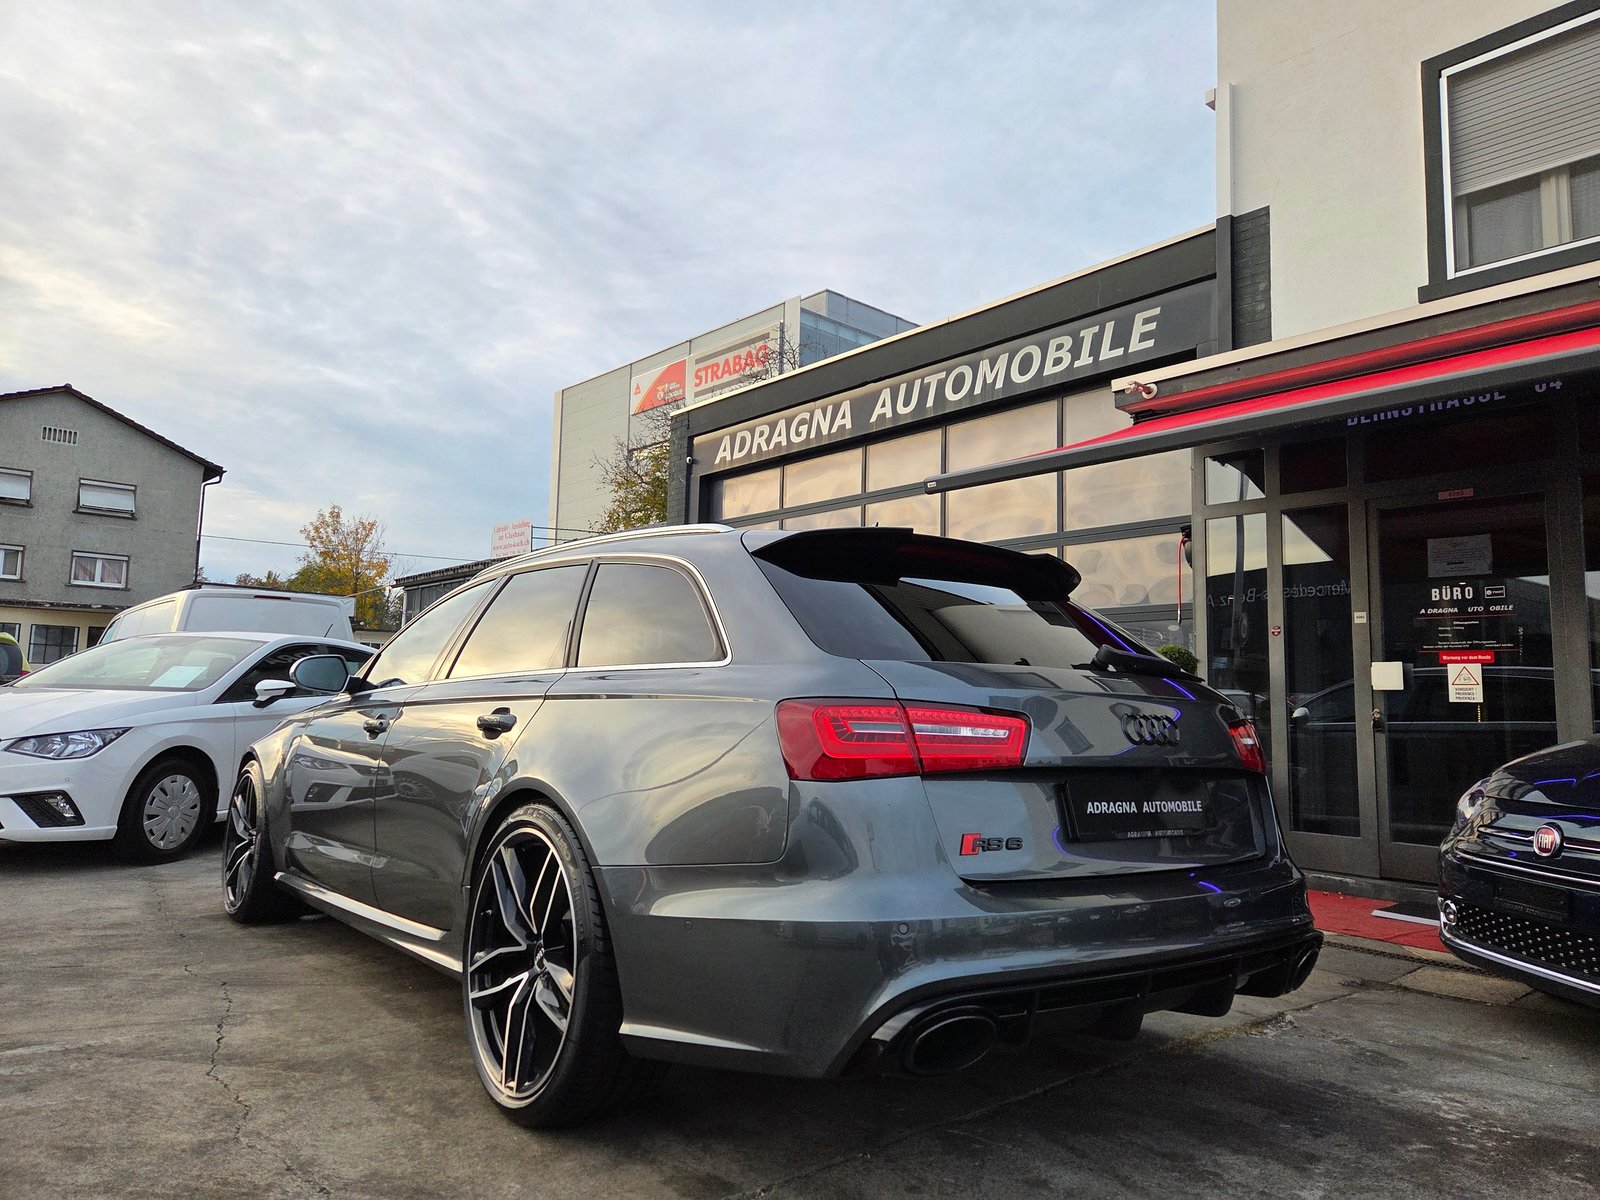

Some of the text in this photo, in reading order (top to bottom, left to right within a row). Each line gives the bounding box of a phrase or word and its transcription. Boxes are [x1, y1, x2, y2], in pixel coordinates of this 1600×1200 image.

[693, 344, 769, 388] STRABAG
[714, 306, 1161, 464] ADRAGNA AUTOMOBILE
[1431, 586, 1473, 601] BÜRO
[1086, 800, 1202, 814] ADRAGNA AUTOMOBILE
[1538, 833, 1554, 849] FIAT
